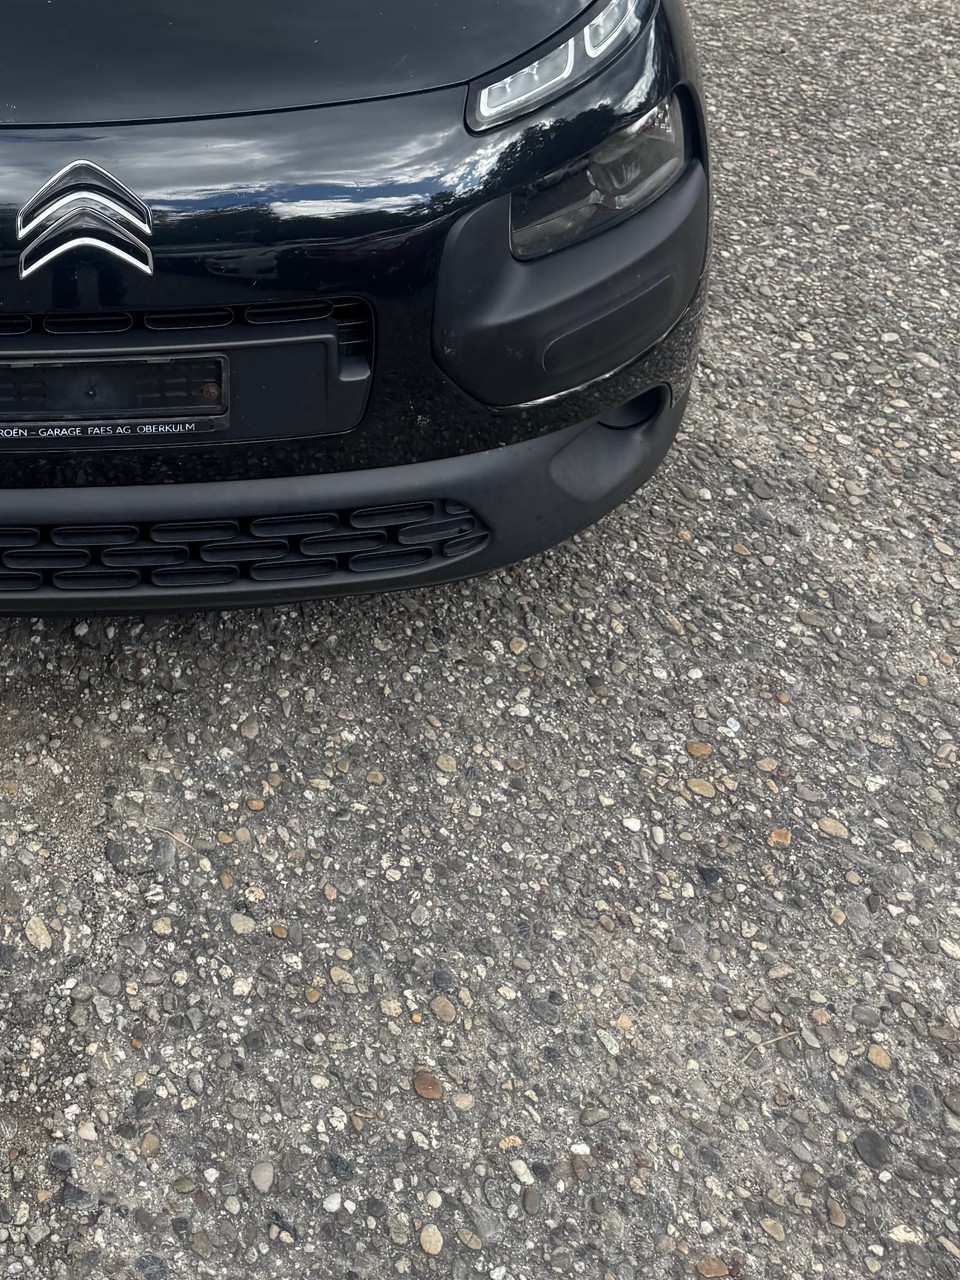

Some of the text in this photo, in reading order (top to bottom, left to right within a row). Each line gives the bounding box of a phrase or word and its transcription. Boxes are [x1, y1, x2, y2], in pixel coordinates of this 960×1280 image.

[38, 427, 82, 437] GARAGE
[87, 426, 113, 435] FAES
[116, 425, 131, 434] AG
[136, 423, 196, 433] OBERKULM
